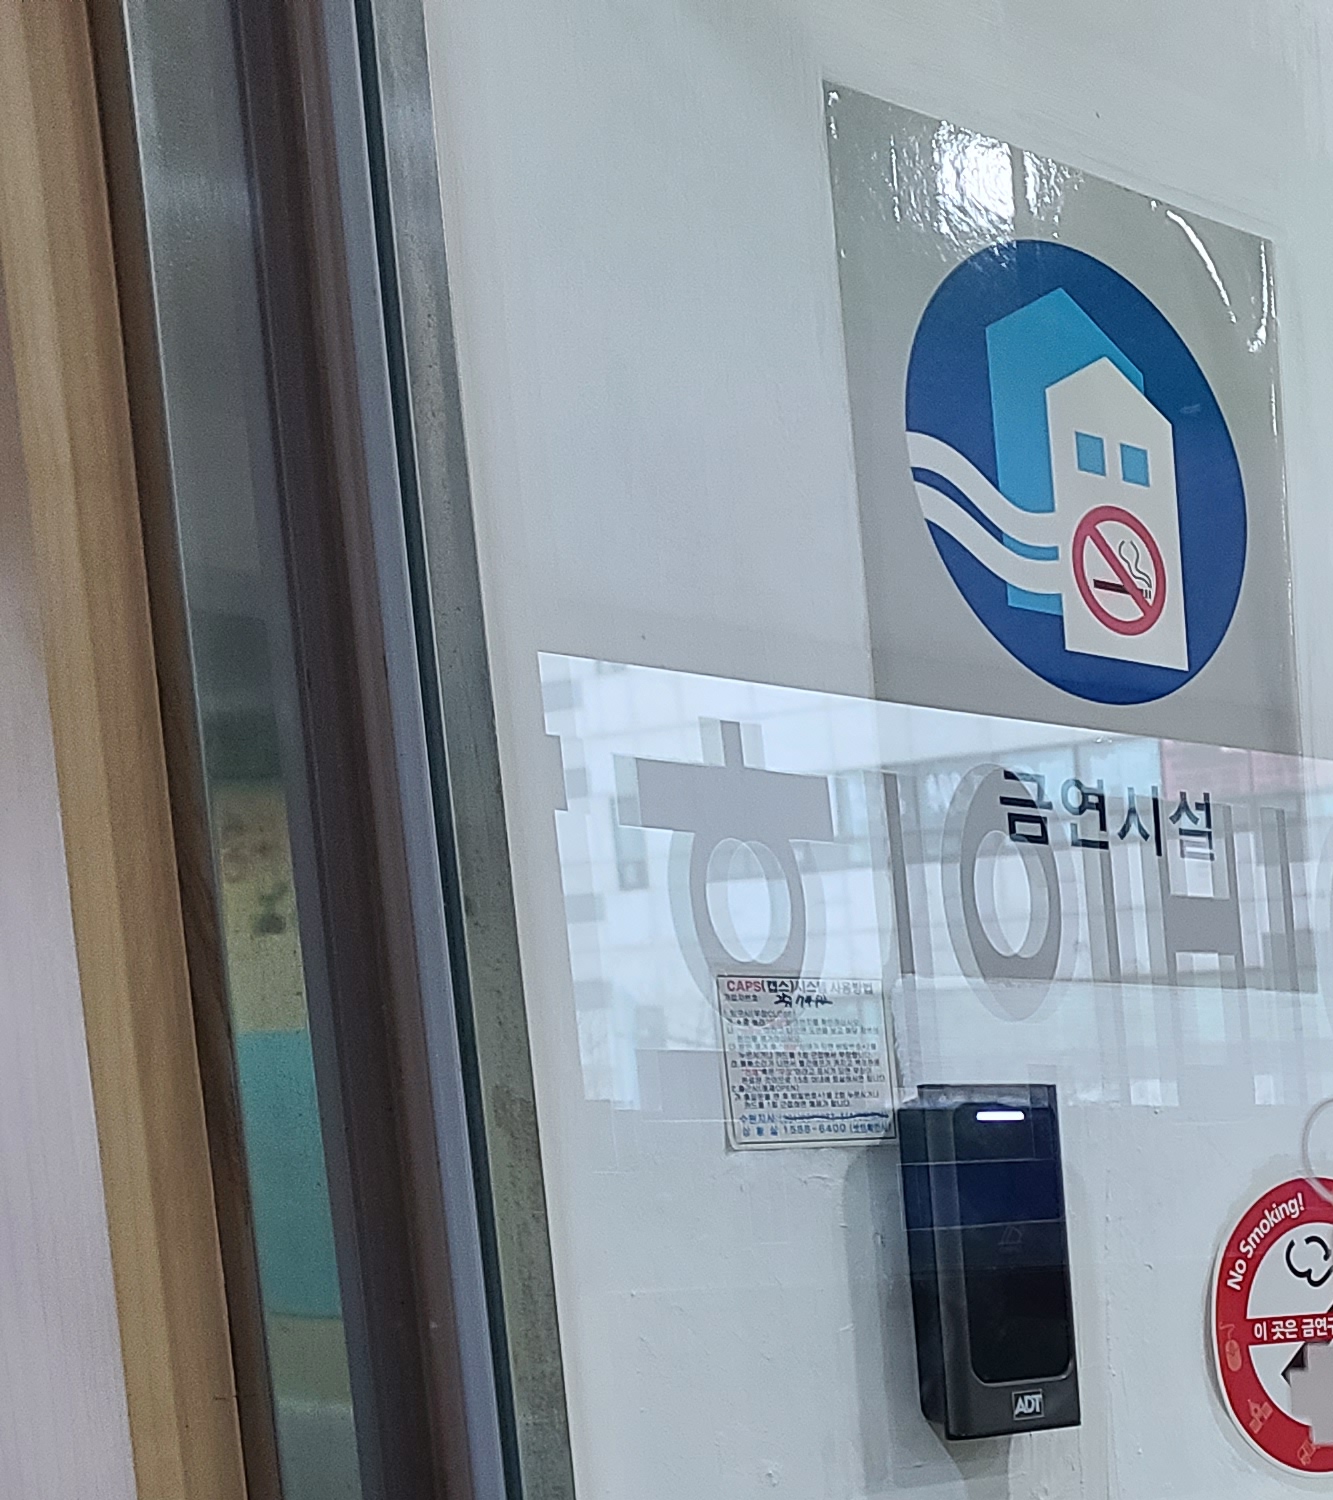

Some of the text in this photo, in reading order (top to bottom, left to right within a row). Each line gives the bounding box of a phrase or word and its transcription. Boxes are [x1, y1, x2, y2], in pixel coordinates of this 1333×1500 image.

[999, 769, 1215, 861] 금연시설
[1226, 1192, 1305, 1291] No Smoking!
[1253, 1320, 1268, 1341] 이
[1270, 1318, 1299, 1341] 곳은
[1014, 1393, 1043, 1416] ADT
